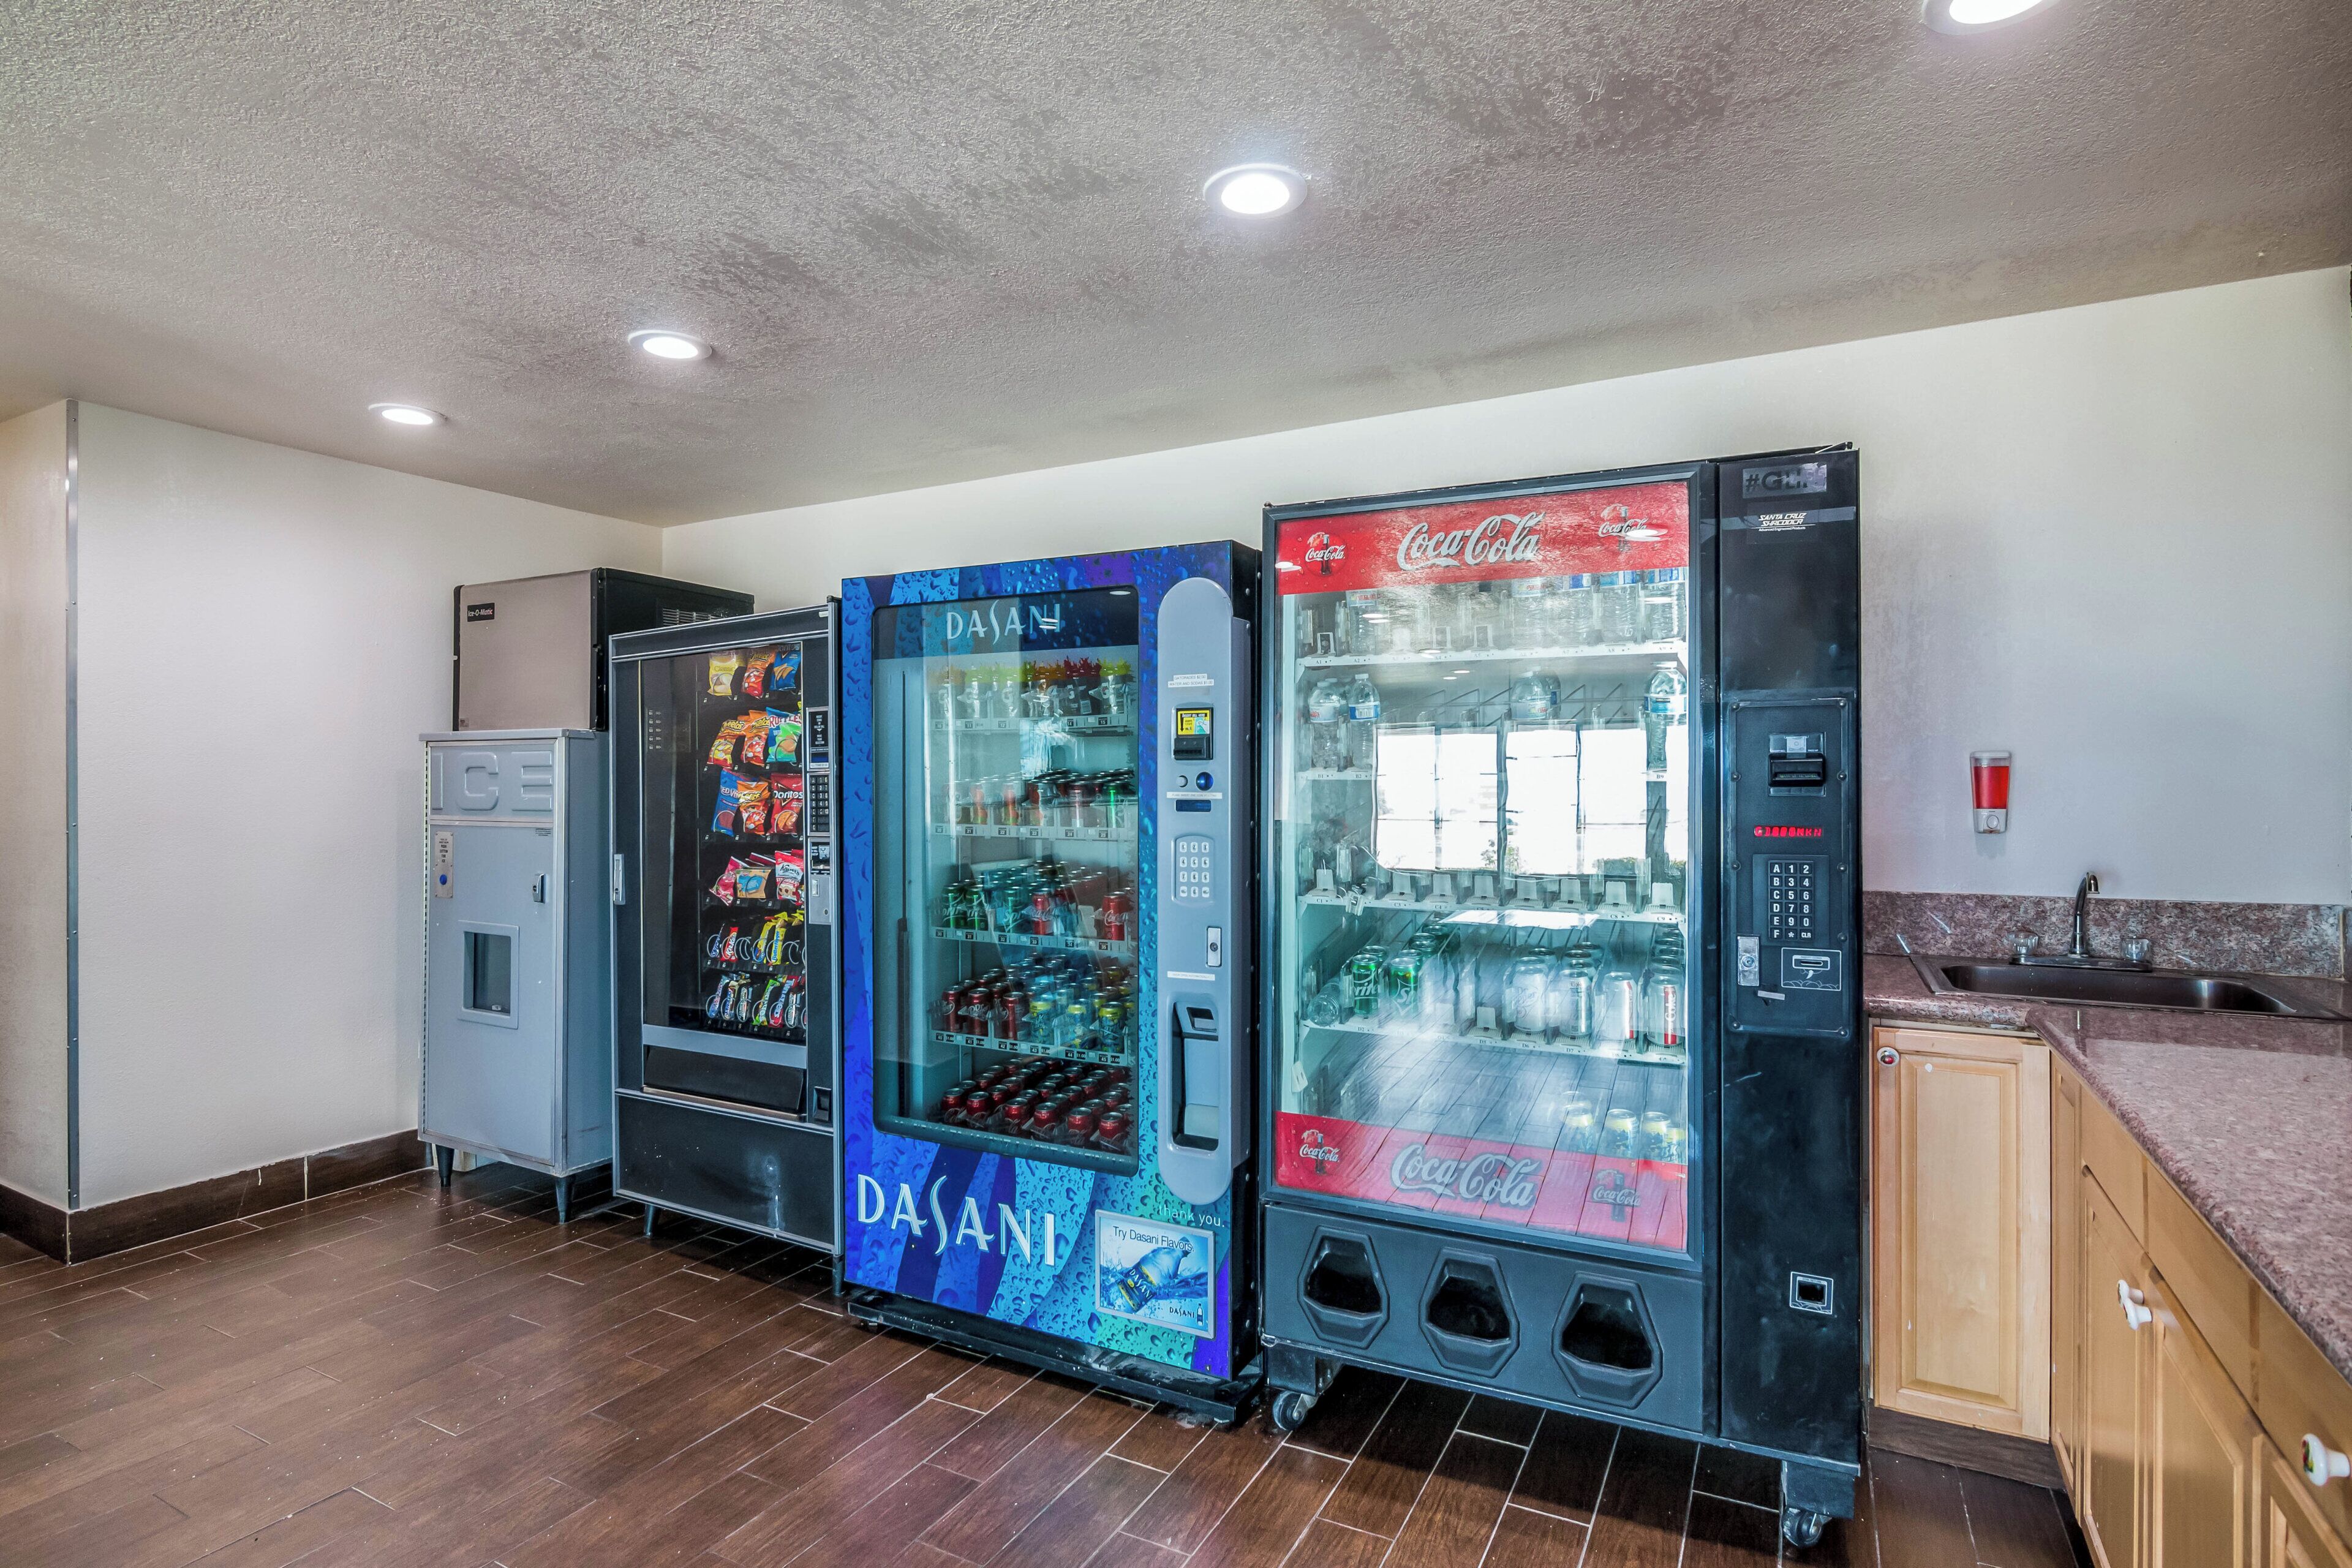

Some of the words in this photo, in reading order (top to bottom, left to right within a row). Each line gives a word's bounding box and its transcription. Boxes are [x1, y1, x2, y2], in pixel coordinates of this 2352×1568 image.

[1396, 511, 1546, 571] Coca-Cola
[1305, 545, 1346, 562] Coca-Cola
[468, 608, 493, 617] Ice-O-Matic
[947, 600, 1060, 645] DASANI
[430, 750, 552, 812] ICE
[774, 790, 803, 799] Doritos
[1773, 864, 1780, 873] A
[1789, 865, 1793, 873] 1
[1803, 865, 1809, 873] 2
[1773, 877, 1779, 886] B
[1789, 878, 1794, 886] 3
[1773, 891, 1780, 899] C
[1789, 891, 1794, 899] 5
[1803, 891, 1809, 900] 6
[1773, 903, 1780, 912] D
[1789, 904, 1794, 913] 7
[1803, 905, 1809, 913] 8
[1789, 918, 1794, 926] 9
[1803, 918, 1809, 926] 0
[1774, 930, 1779, 938] F
[771, 930, 780, 962] Butterfinger
[1298, 1143, 1340, 1163] Coca-Cola
[1390, 1143, 1541, 1208] Coca-Cola
[858, 1174, 1055, 1267] DASANI
[1158, 1204, 1194, 1221] thank
[1199, 1214, 1225, 1227] you.
[1113, 1226, 1127, 1240] Try
[1129, 1229, 1159, 1245] Dasani
[1161, 1235, 1194, 1252] Flavors.
[1129, 1268, 1153, 1300] DASANI
[1169, 1306, 1194, 1319] DASANI
